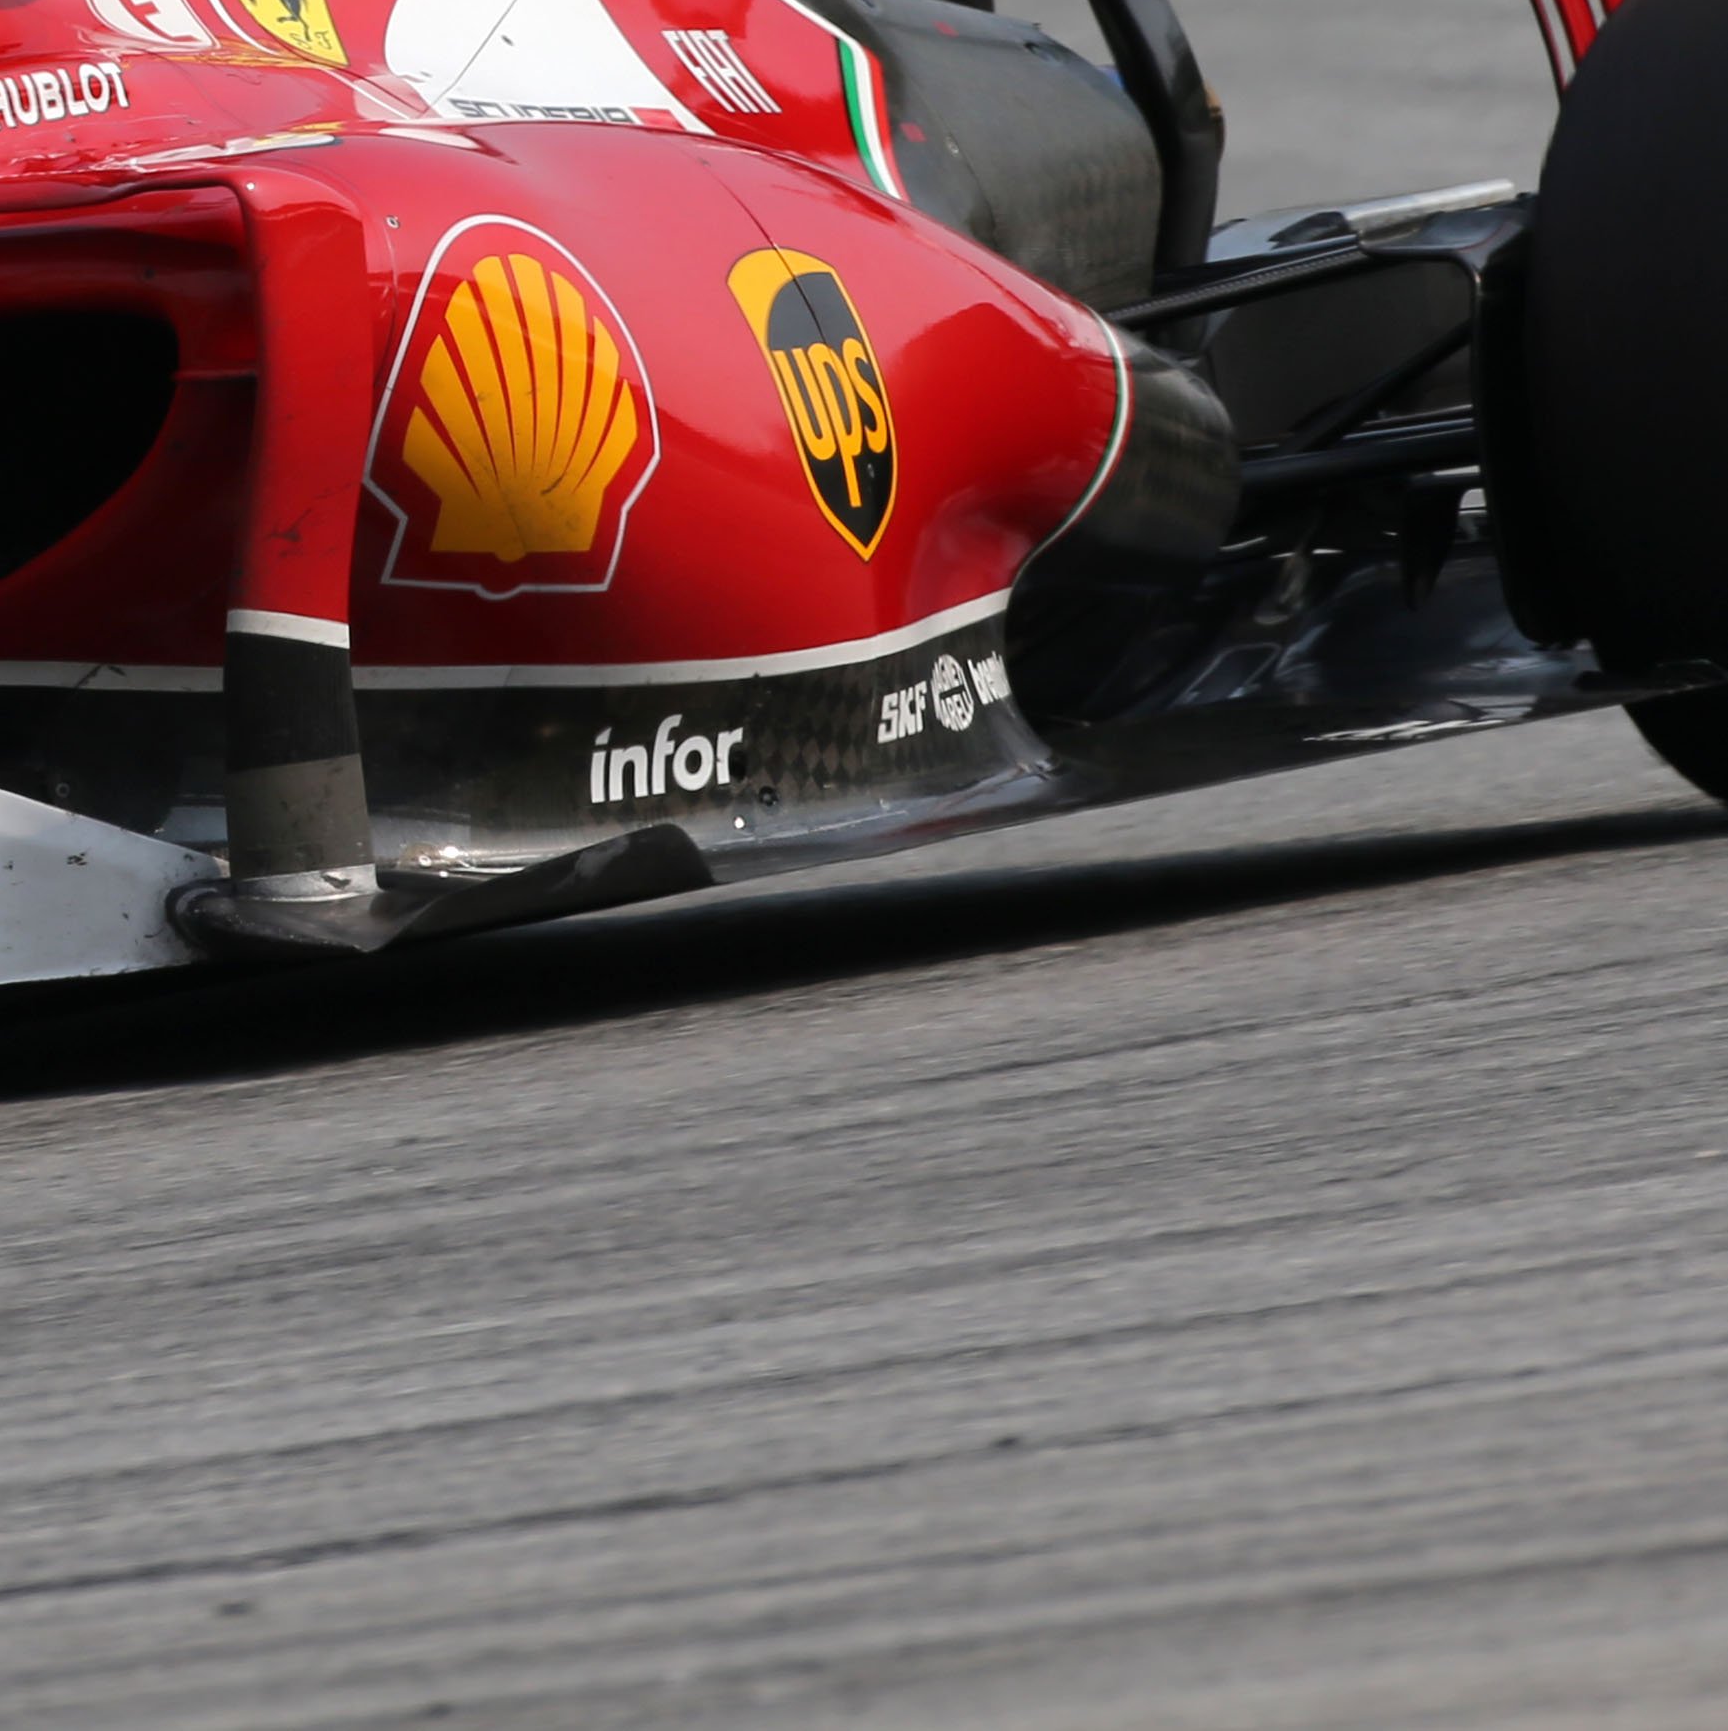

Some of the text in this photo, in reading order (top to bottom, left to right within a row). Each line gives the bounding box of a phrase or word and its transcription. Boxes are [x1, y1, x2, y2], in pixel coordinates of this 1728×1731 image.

[660, 28, 783, 113] FIAT
[877, 680, 927, 744] SKF
[590, 713, 744, 804] infor
